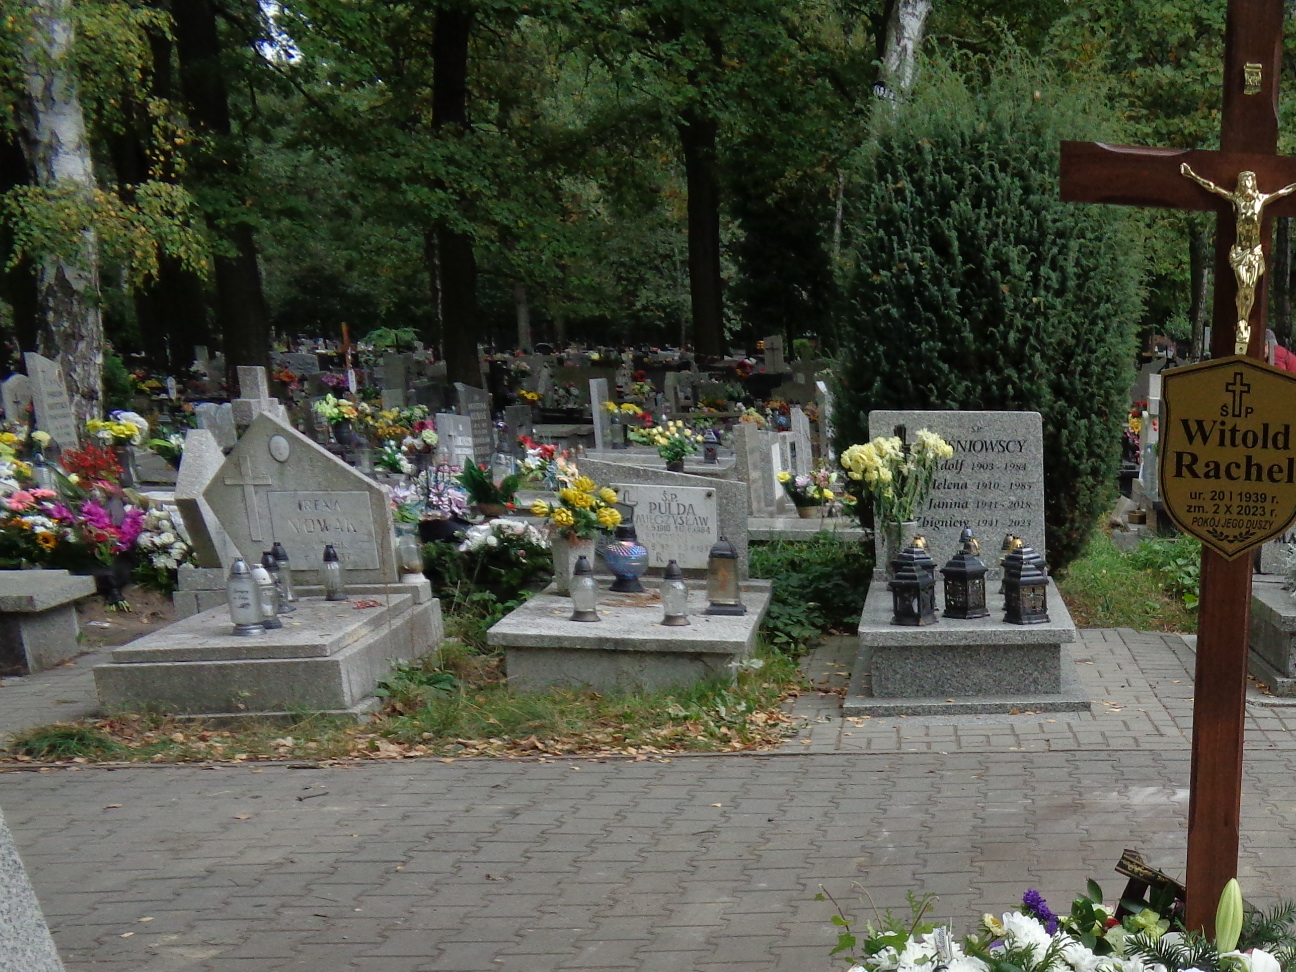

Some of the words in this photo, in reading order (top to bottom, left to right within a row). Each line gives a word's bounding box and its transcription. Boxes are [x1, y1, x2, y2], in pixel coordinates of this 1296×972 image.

[1245, 406, 1254, 418] P
[1180, 418, 1291, 451] Witold
[945, 436, 1027, 454] ŚNIOWSCY
[1172, 451, 1295, 484] Rachel
[1189, 491, 1206, 501] ur.
[1210, 490, 1225, 501] 20
[1237, 491, 1267, 503] 1939
[1271, 495, 1279, 504] r.
[648, 501, 696, 516] PULDA
[928, 498, 969, 511] Janina
[1186, 504, 1208, 514] zm.
[1212, 503, 1220, 514] 2
[1224, 503, 1233, 515] X
[1236, 504, 1266, 517] 2023
[1270, 508, 1278, 517] r.
[1221, 518, 1244, 529] JEGO
[1245, 519, 1274, 530] DUSZY
